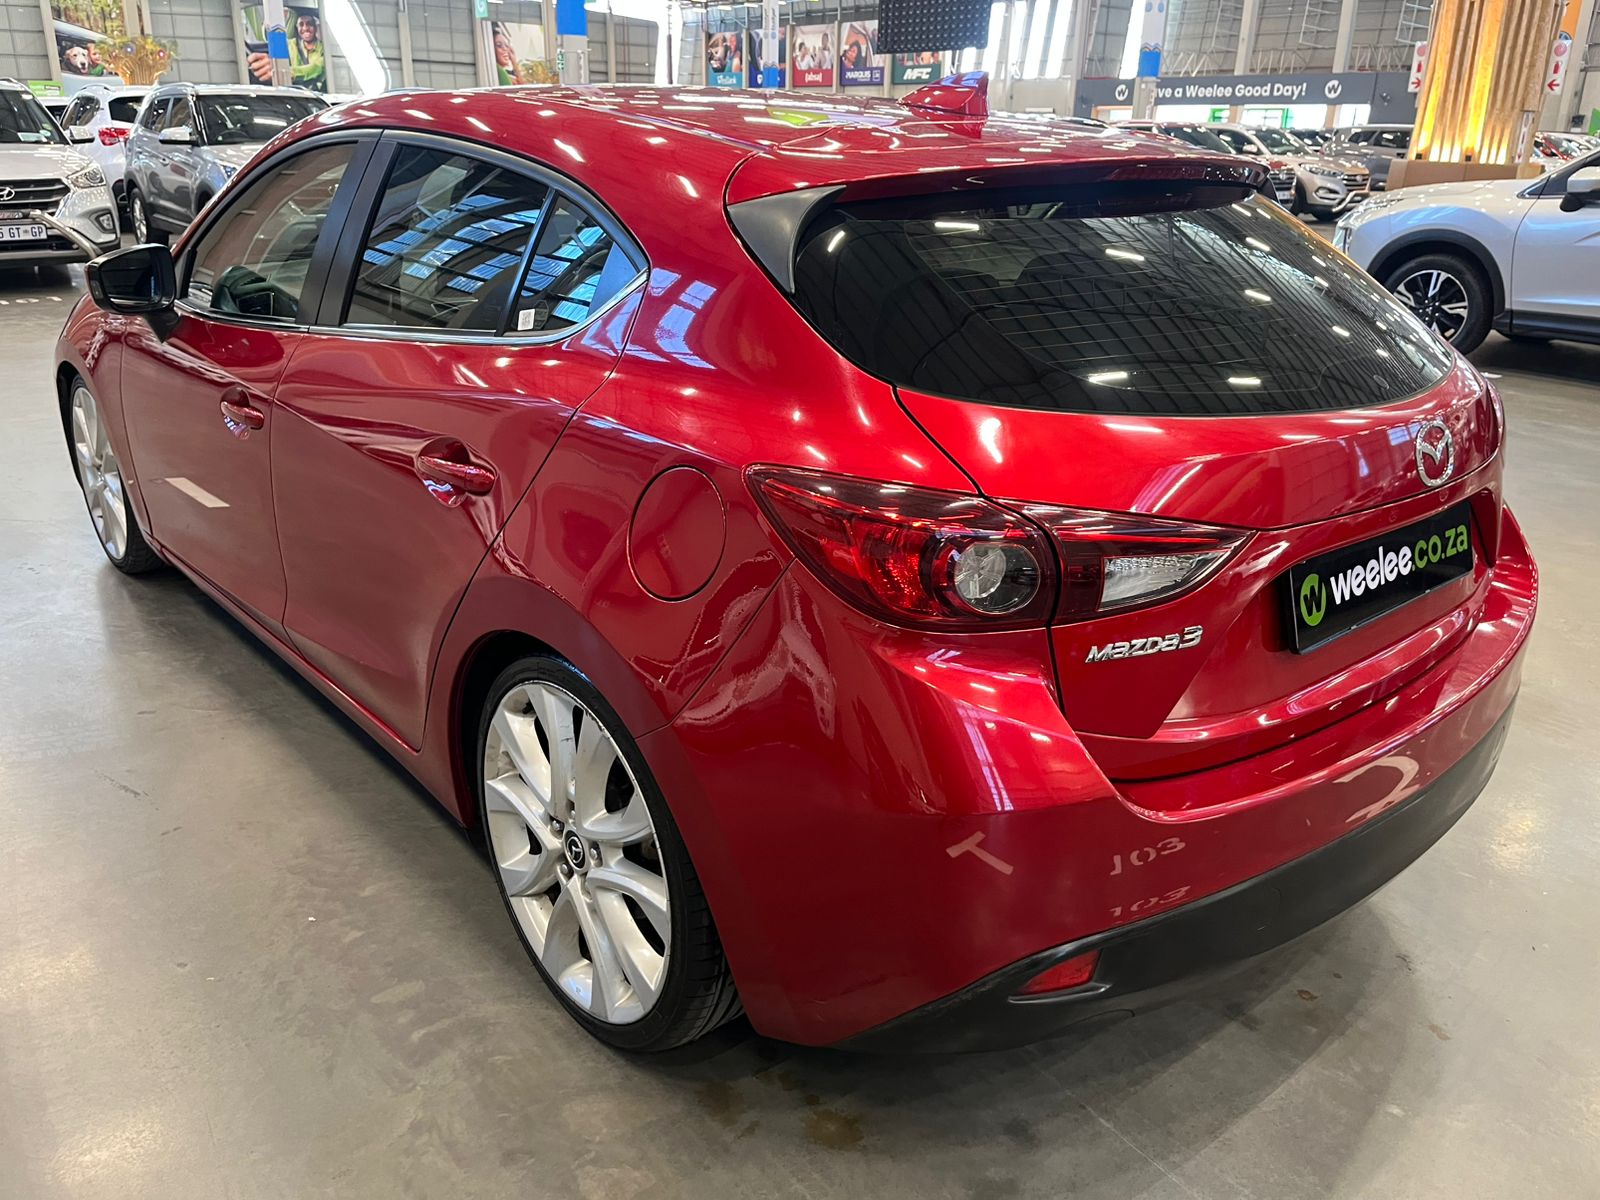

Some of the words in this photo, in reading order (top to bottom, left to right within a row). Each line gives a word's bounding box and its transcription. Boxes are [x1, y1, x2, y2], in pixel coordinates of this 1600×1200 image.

[903, 68, 932, 80] MFC
[1174, 87, 1183, 98] a
[1185, 84, 1233, 98] Weelee
[1235, 83, 1271, 97] Good
[1273, 82, 1307, 100] Day!
[8, 227, 21, 238] GT
[31, 226, 44, 237] GP
